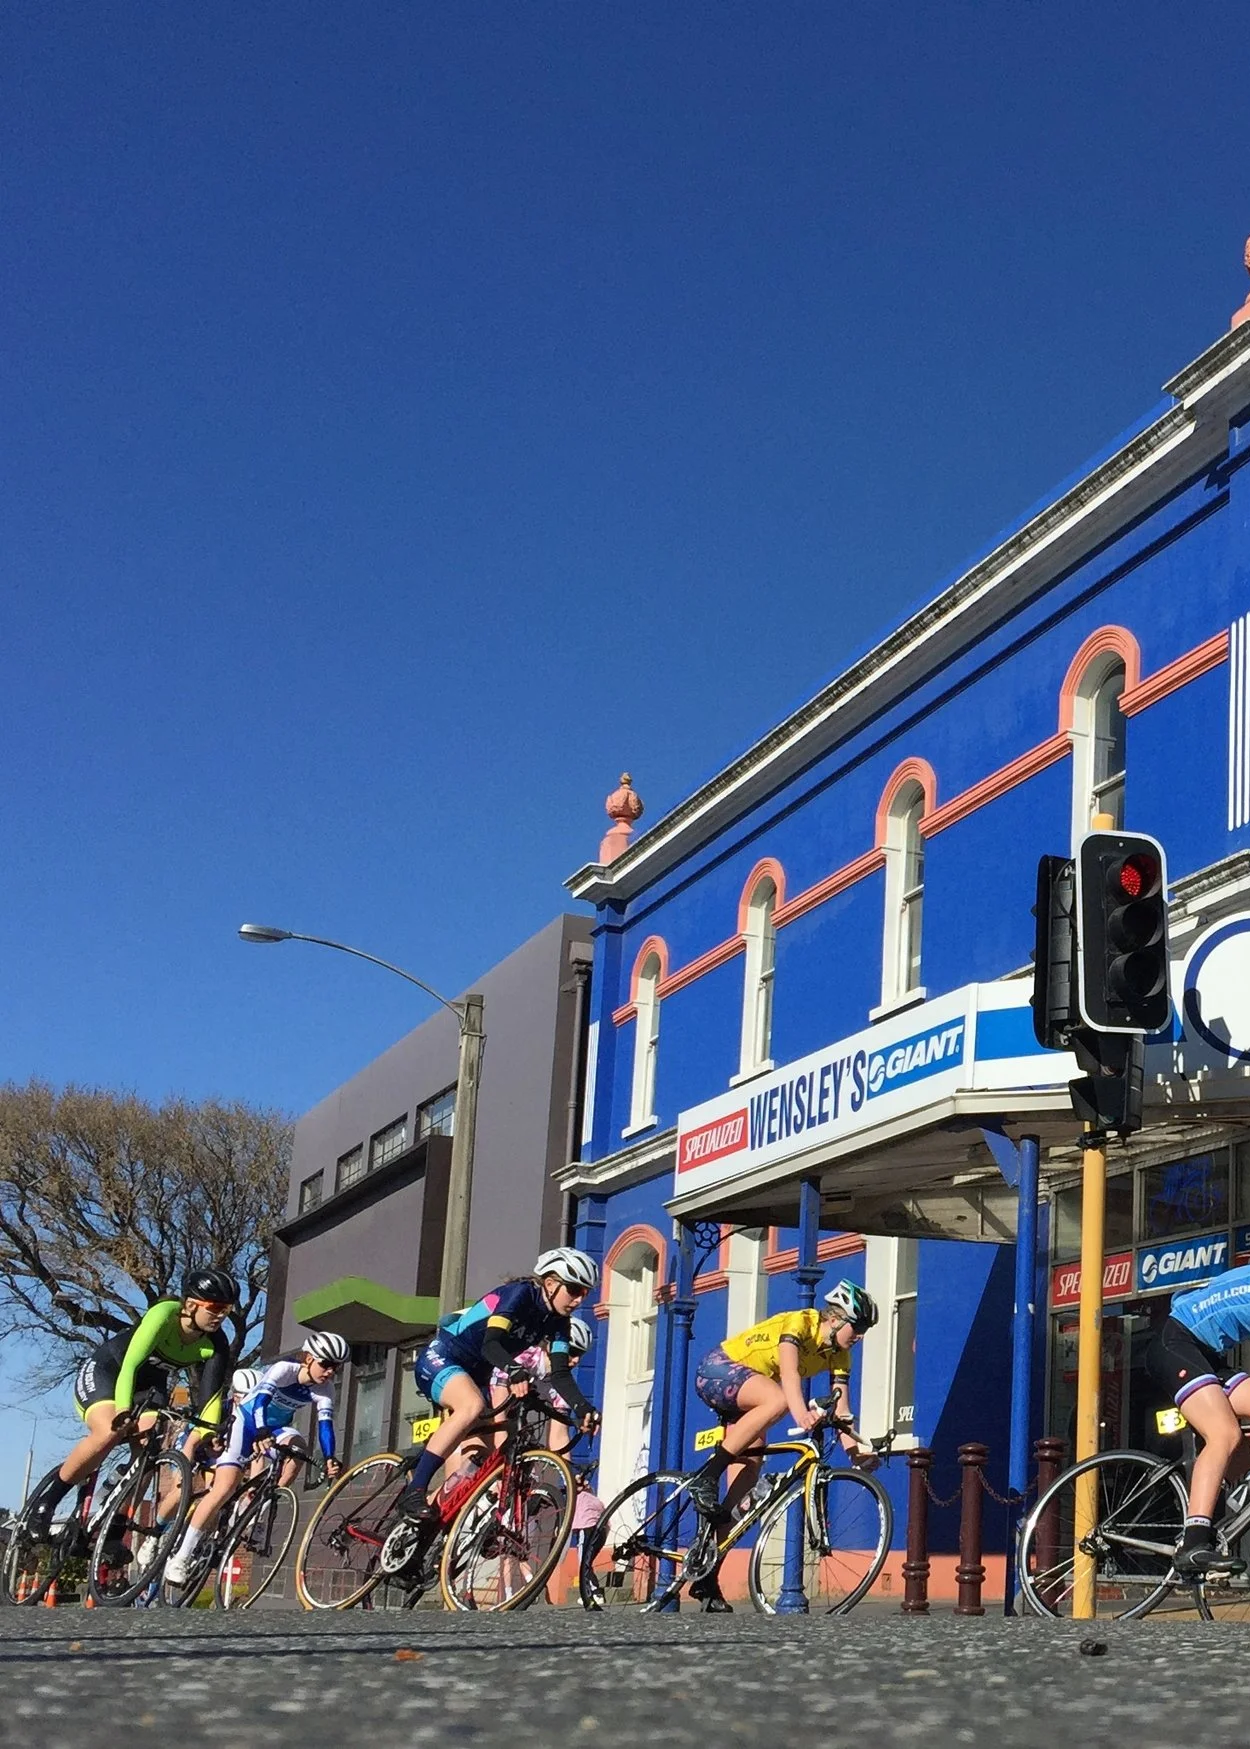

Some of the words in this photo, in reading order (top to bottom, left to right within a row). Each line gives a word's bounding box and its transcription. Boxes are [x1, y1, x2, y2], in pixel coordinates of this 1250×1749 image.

[884, 1024, 965, 1079] GIANT
[749, 1049, 867, 1151] WENSLEY'S
[682, 1117, 745, 1164] SPECIALIZED
[1157, 1241, 1228, 1276] GIANT
[415, 1422, 432, 1439] 49
[698, 1431, 715, 1447] 45
